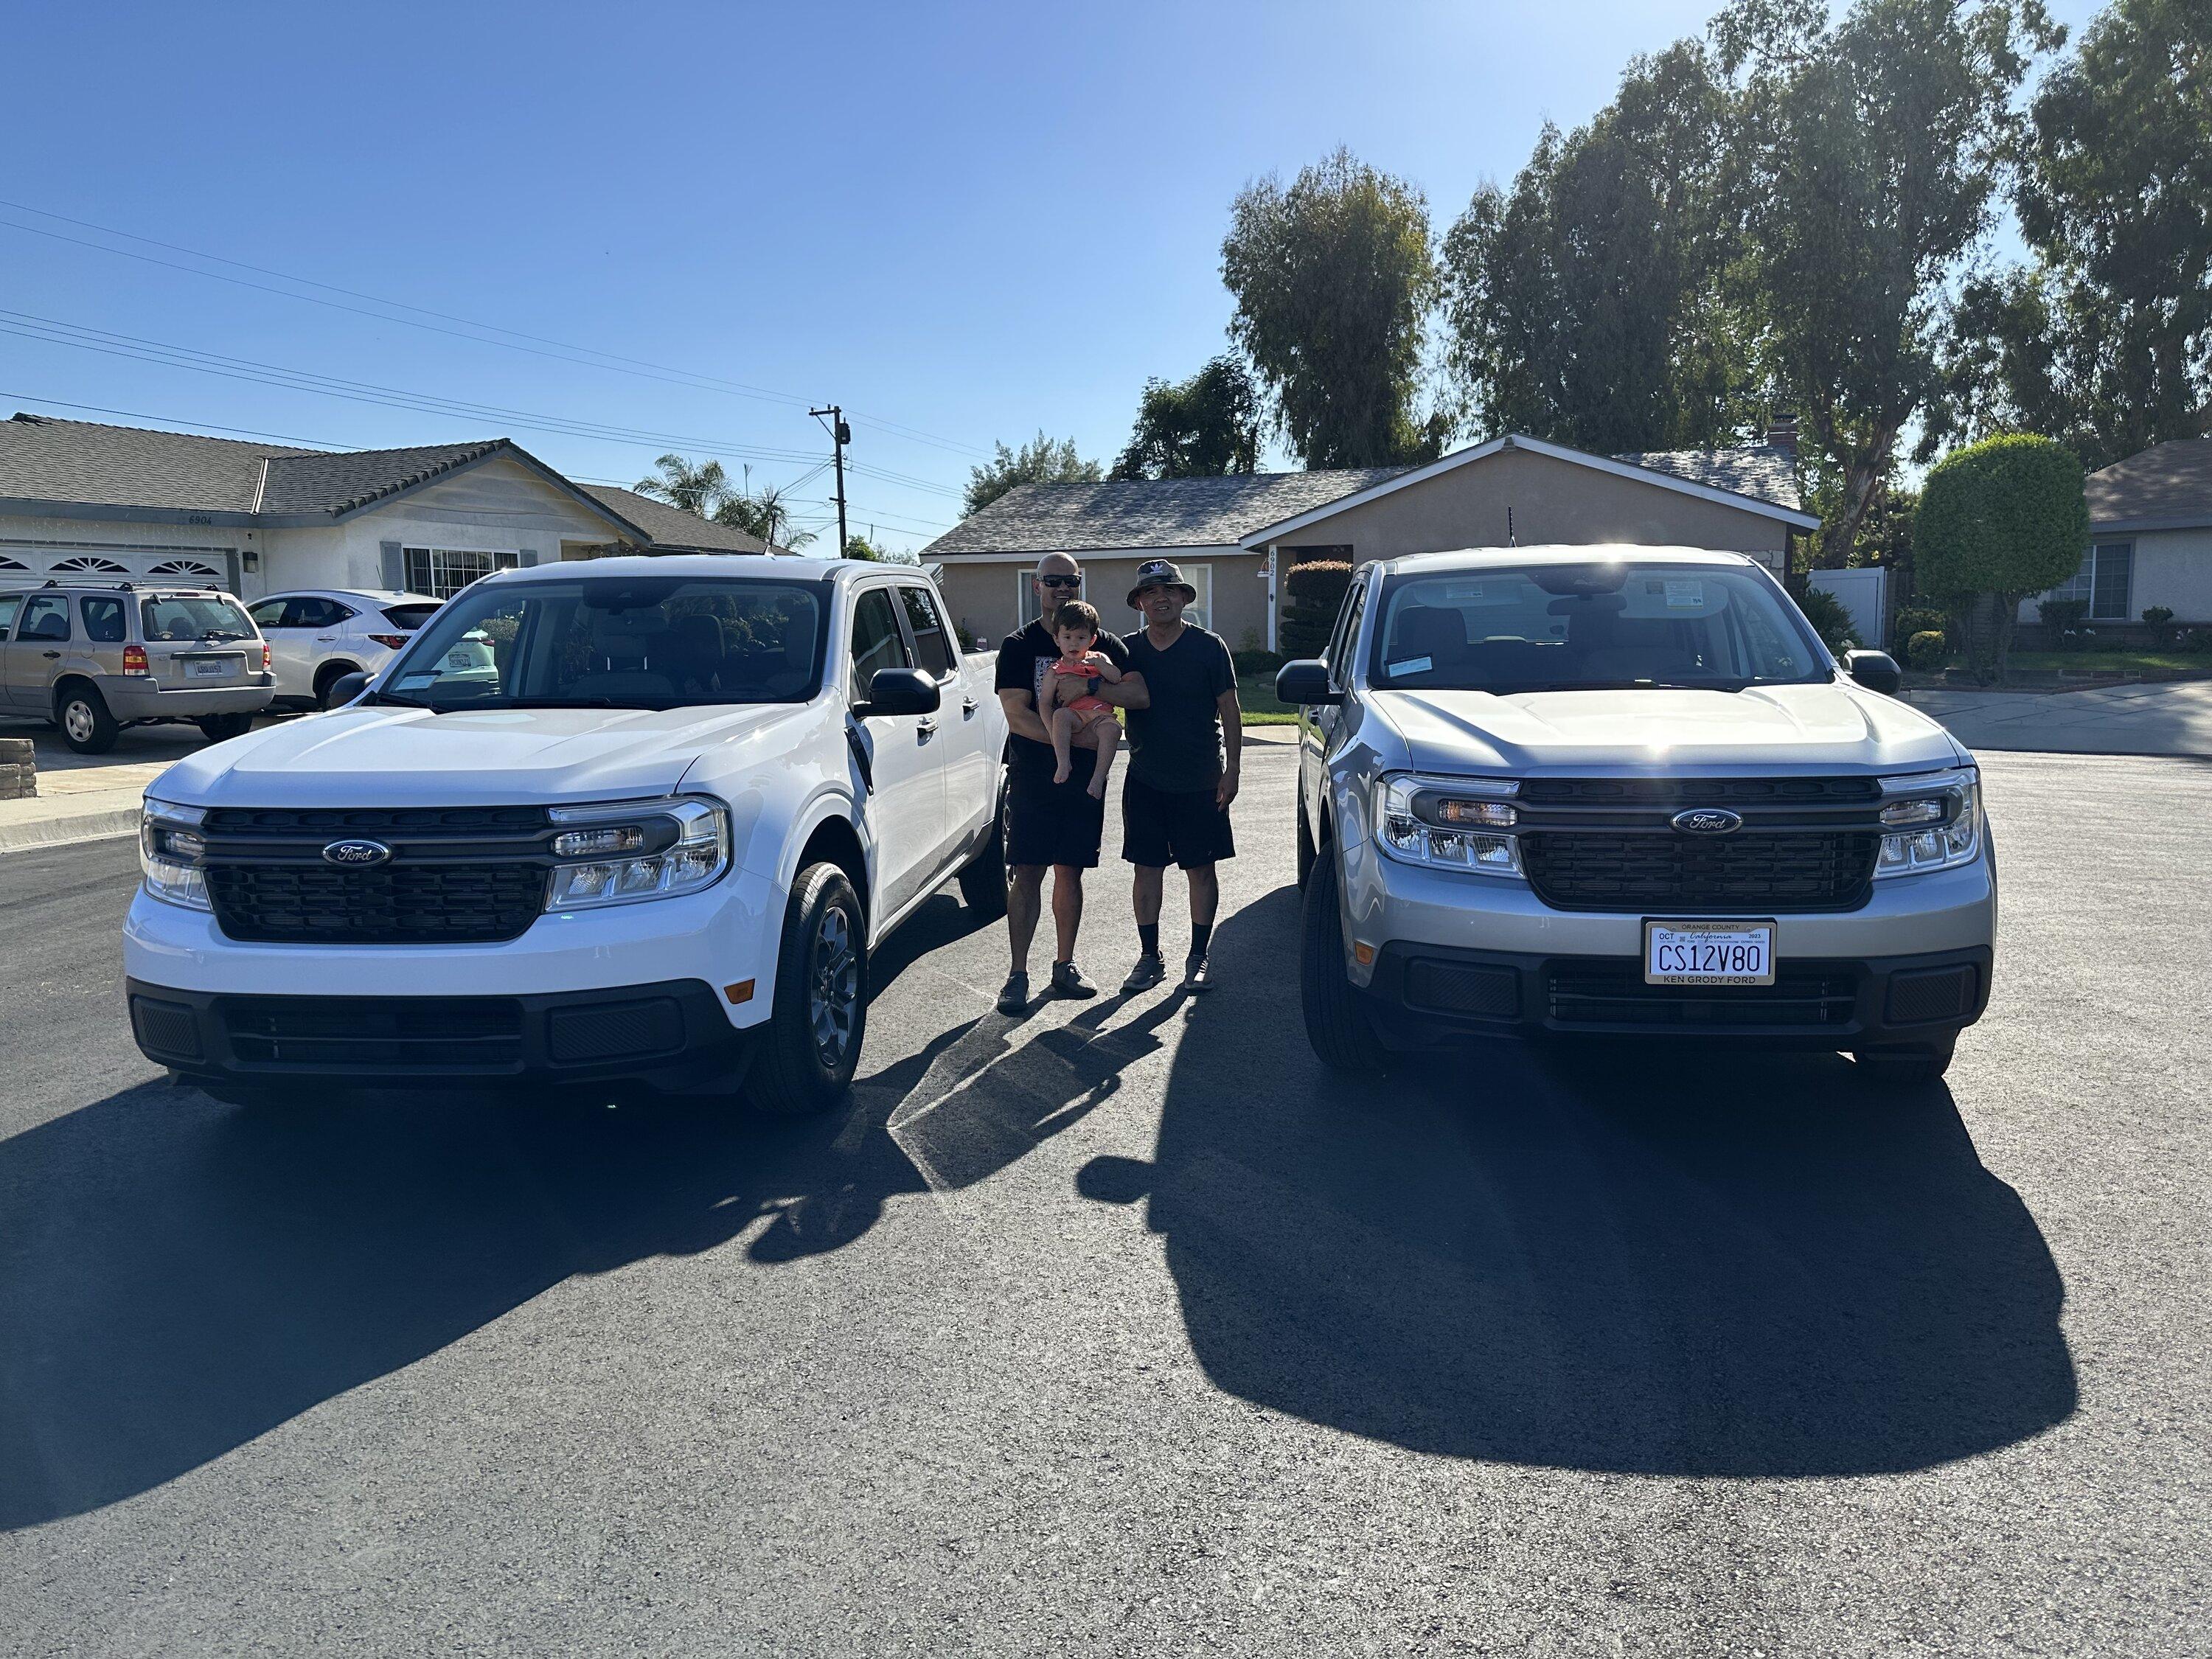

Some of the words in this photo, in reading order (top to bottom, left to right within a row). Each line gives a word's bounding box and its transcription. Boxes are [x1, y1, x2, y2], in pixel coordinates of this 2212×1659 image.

[189, 515, 212, 525] 6904
[1689, 814, 1726, 829] Ford
[337, 845, 372, 861] Ford
[1690, 932, 1732, 943] California
[1659, 945, 1760, 972] CS12V80
[1663, 975, 1684, 984] KEN
[1688, 975, 1724, 984] GRODY
[1727, 976, 1756, 984] FORD
